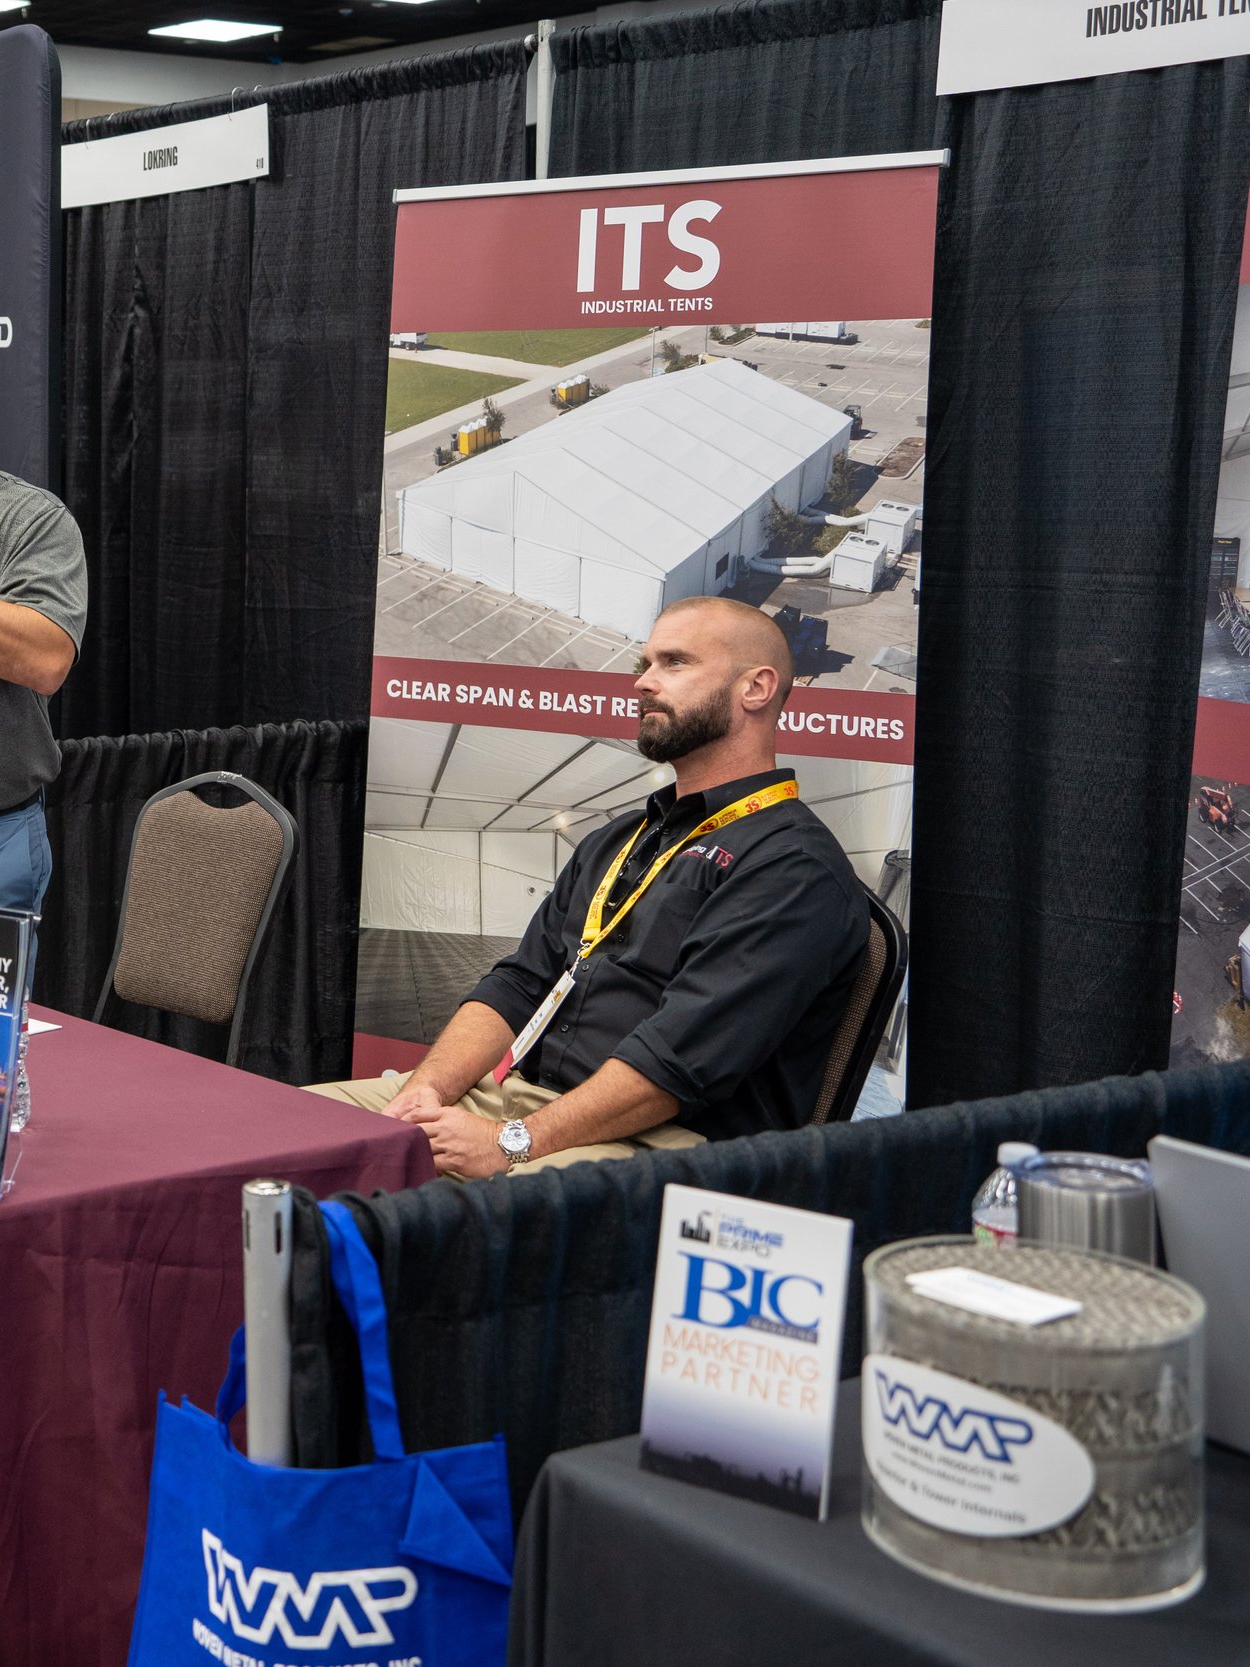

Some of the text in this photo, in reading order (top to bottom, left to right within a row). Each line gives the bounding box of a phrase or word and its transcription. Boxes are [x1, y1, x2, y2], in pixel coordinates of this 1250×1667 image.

[143, 146, 178, 171] LOKRING
[577, 199, 723, 292] ITS
[581, 297, 713, 314] INDUSTRIAL TENTS
[386, 679, 450, 702] CLEAR
[455, 684, 514, 707] SPAN
[518, 689, 534, 709] &
[539, 691, 606, 714] BLAST
[716, 1236, 770, 1259] EXPO
[671, 1250, 824, 1330] BIC
[661, 1351, 818, 1413] PARTNER
[663, 1323, 820, 1383] MARKETING
[202, 1528, 418, 1650] WMP
